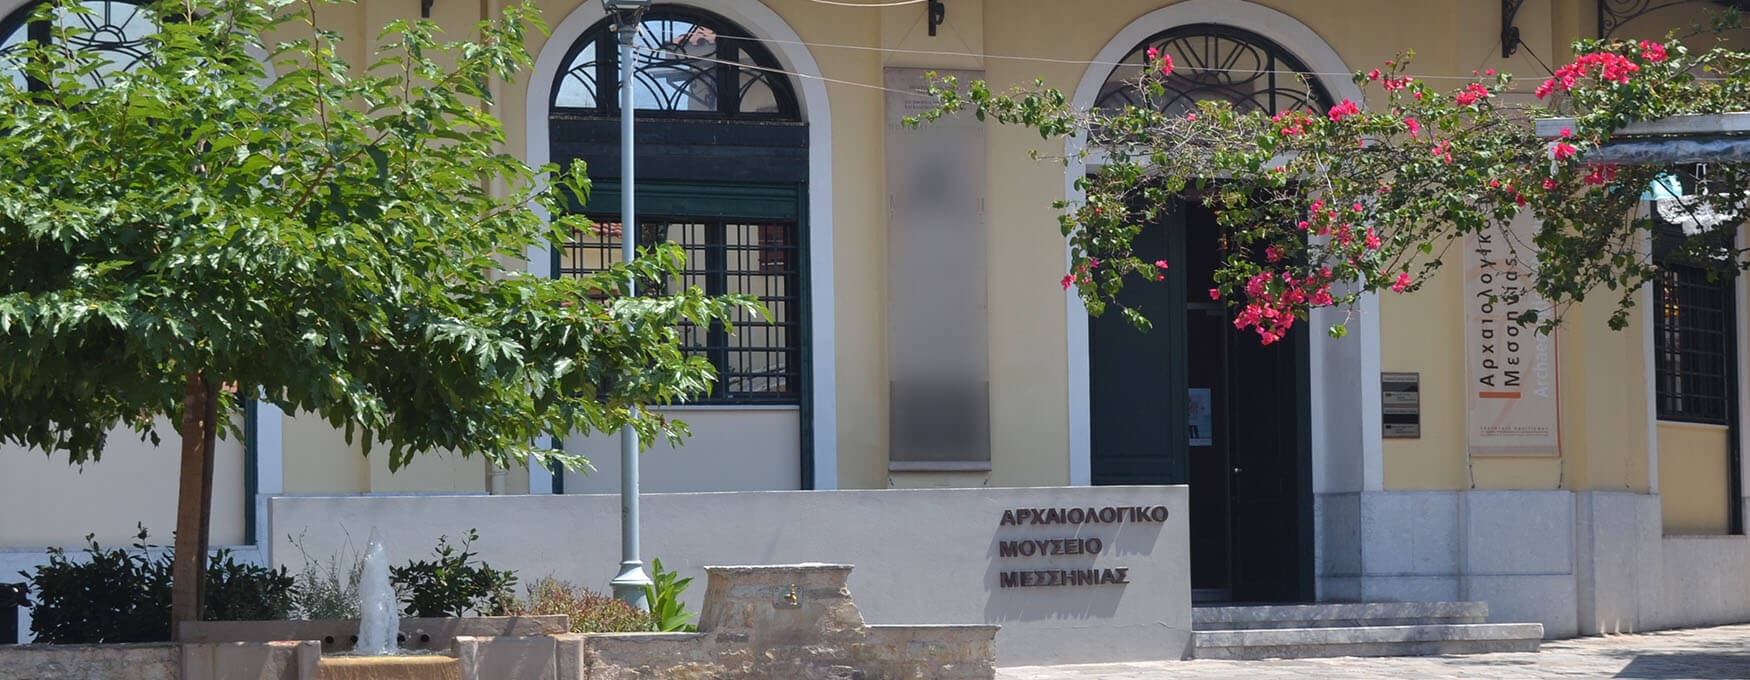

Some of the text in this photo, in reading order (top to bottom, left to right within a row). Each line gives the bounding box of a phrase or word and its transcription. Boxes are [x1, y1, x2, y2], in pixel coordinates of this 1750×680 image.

[1000, 506, 1169, 526] ΑΡΧΑΙΟΛΟΓΙΚΟ
[1000, 538, 1103, 557] ΜΟΥΣΕΙΟ
[1000, 567, 1130, 588] ΜΕΣΣΗΝΙΑΣ
